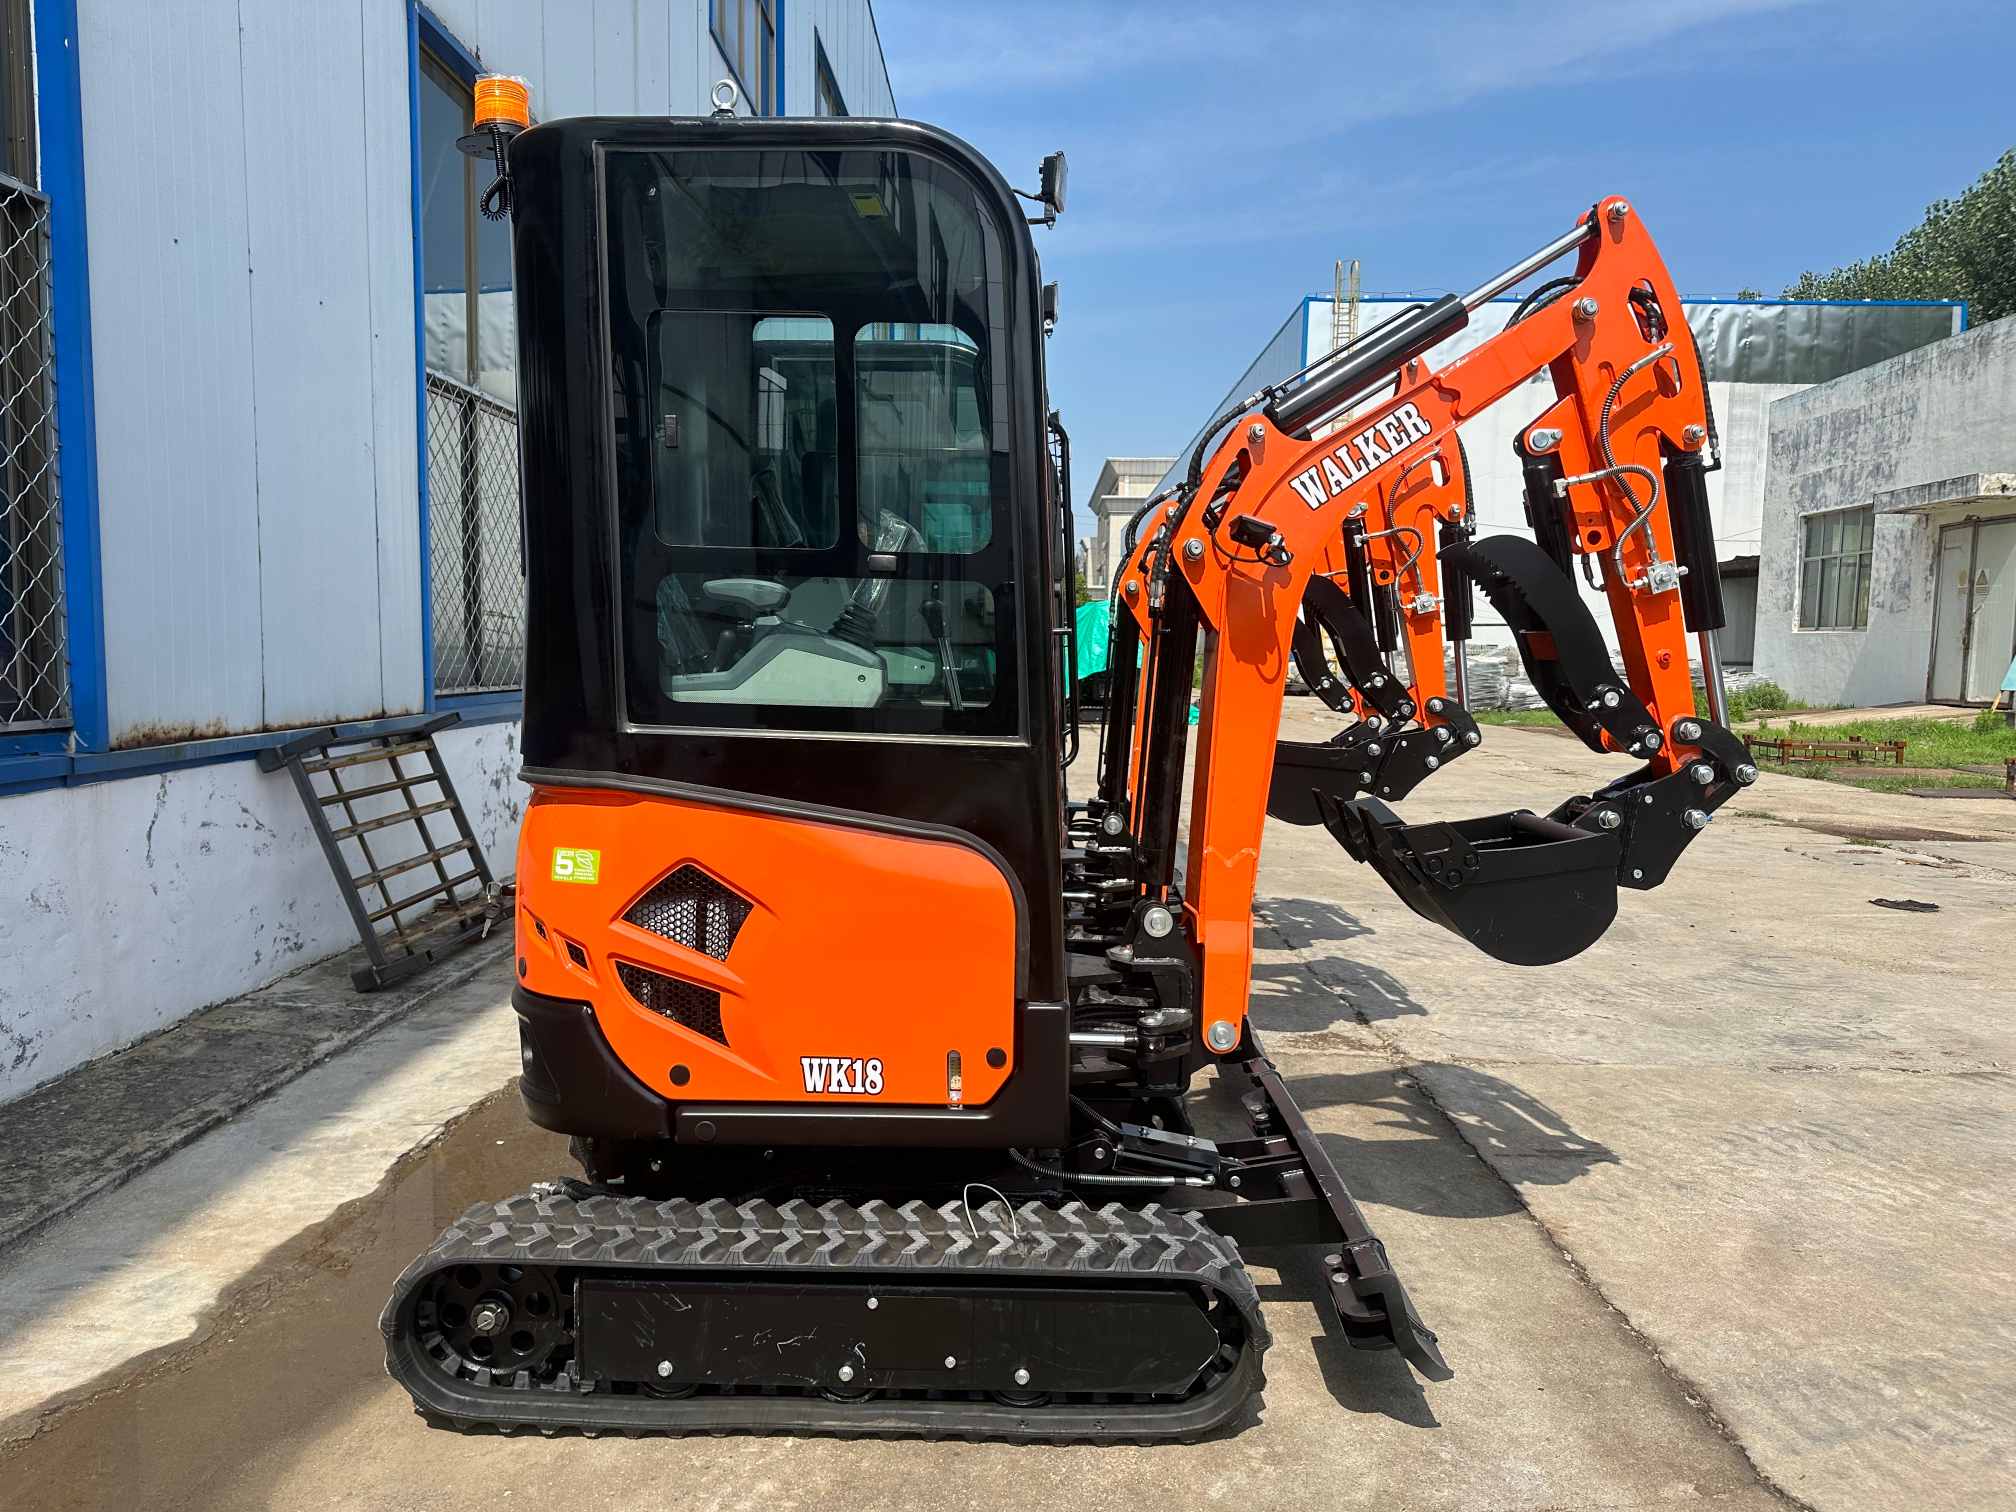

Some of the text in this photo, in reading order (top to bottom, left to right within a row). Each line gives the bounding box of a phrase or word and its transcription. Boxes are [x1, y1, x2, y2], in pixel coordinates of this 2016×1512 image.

[1288, 402, 1432, 511] WALKER
[555, 849, 574, 876] 5
[800, 1056, 884, 1095] WK18
